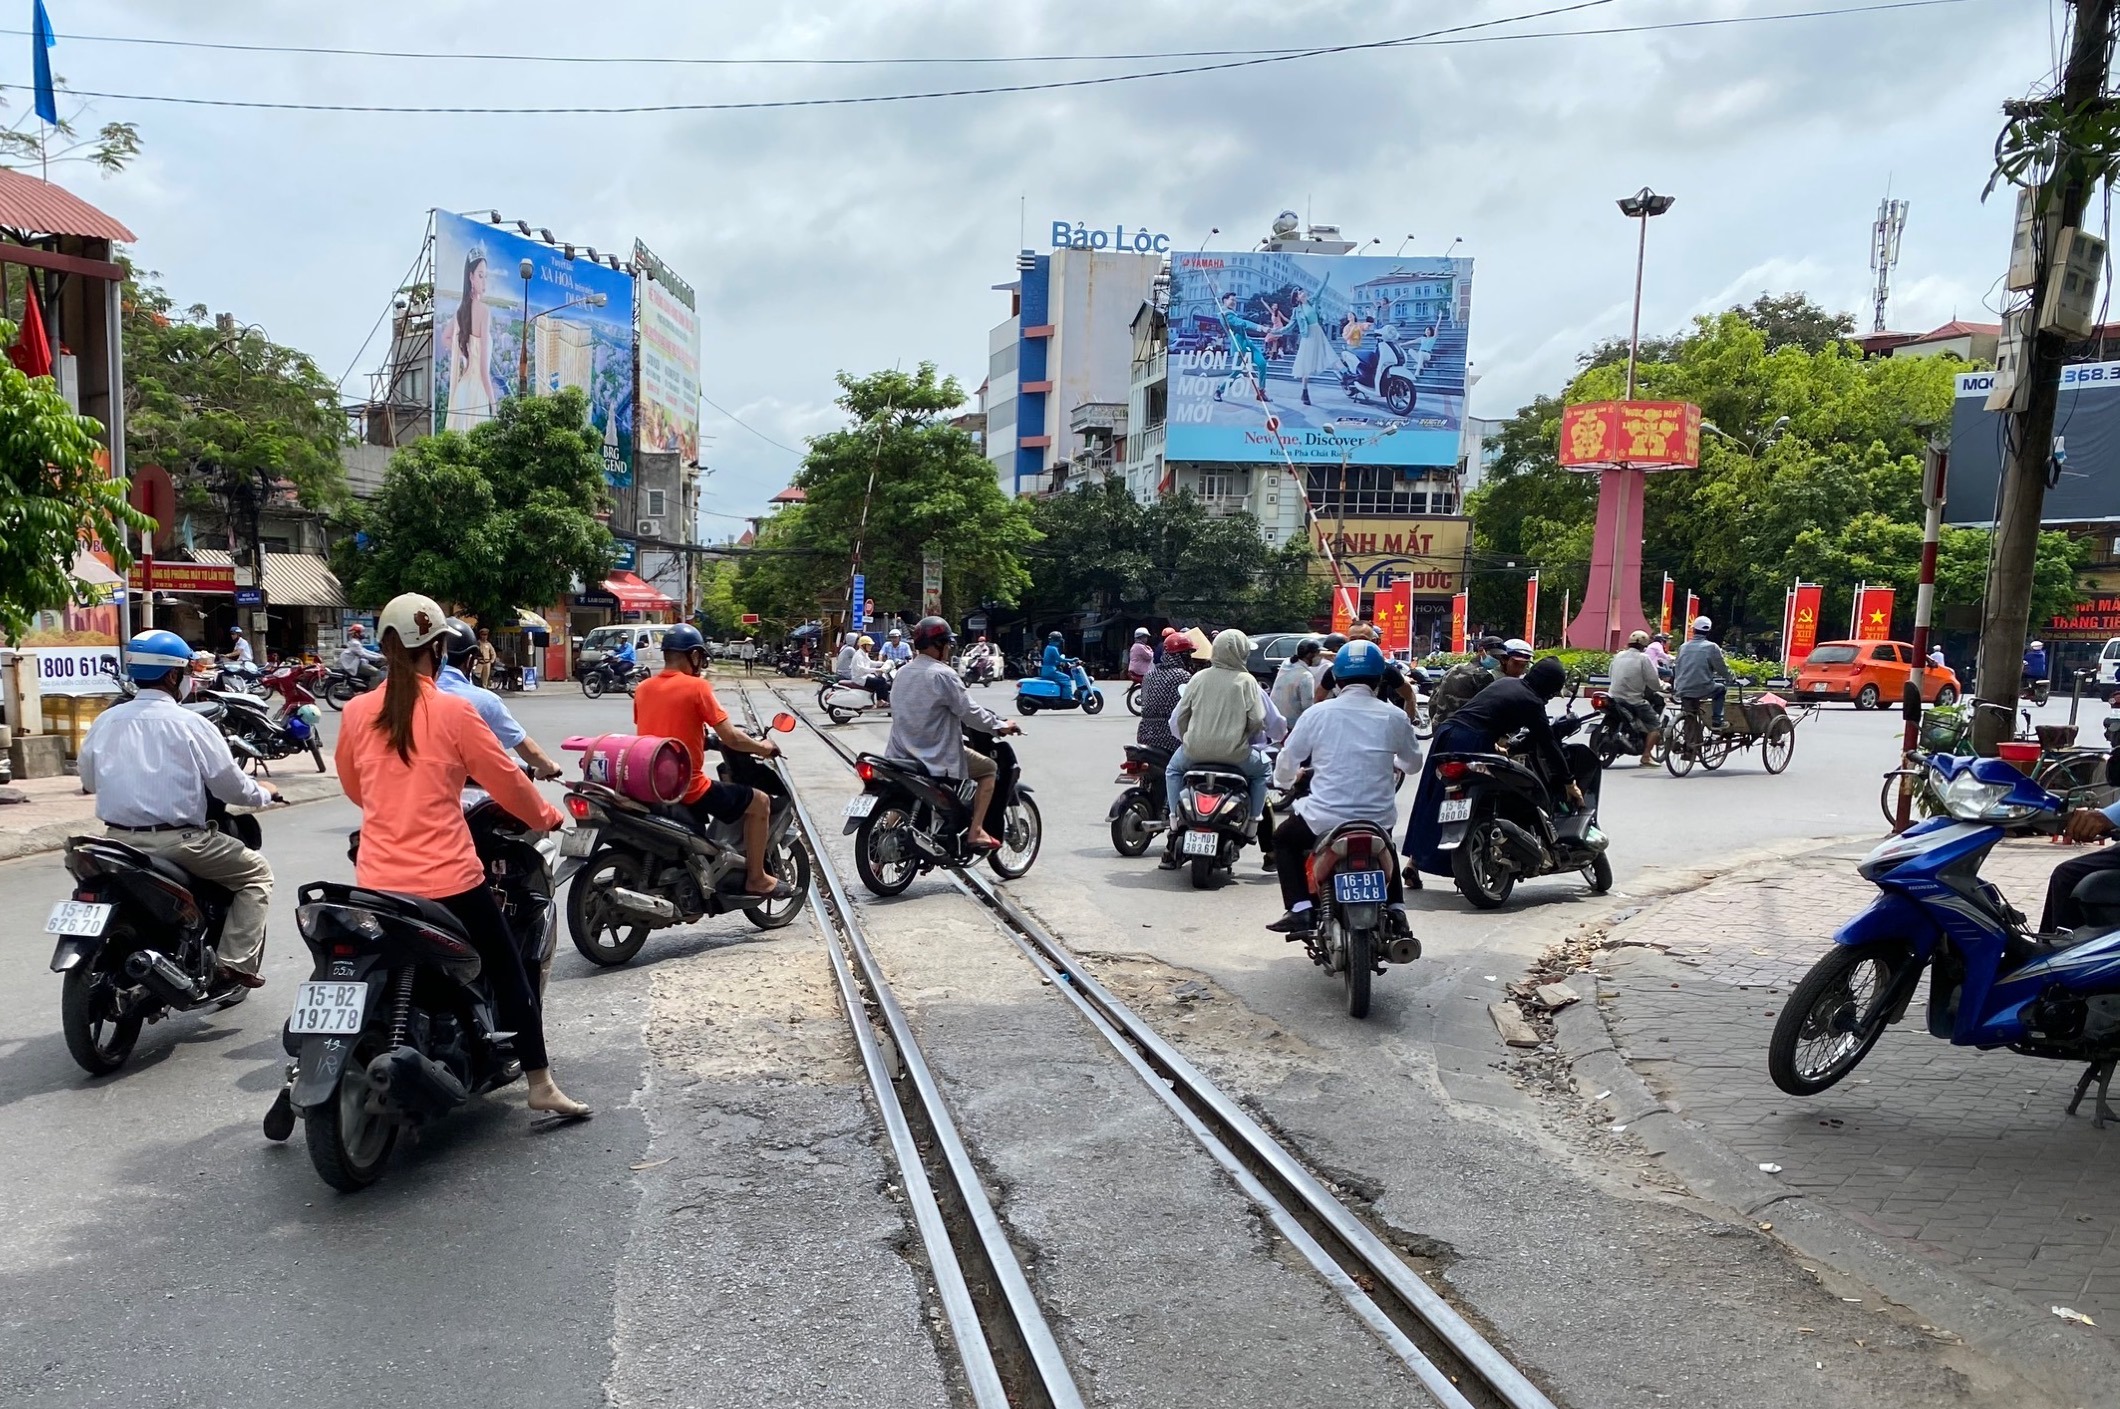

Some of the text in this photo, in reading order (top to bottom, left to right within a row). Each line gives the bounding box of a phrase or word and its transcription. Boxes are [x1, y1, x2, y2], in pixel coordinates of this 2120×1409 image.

[1052, 221, 1170, 257] Bảo Lộc
[1192, 259, 1225, 268] YAMAHA
[555, 270, 574, 289] HOA
[1178, 346, 1254, 371] LUÔN LÀ
[1177, 372, 1252, 398] MỘT TÔI
[1176, 397, 1215, 423] MỚI
[1245, 431, 1274, 445] New
[1305, 432, 1365, 446] Discover
[603, 445, 620, 460] BRG
[603, 459, 627, 474] GEND
[1383, 524, 1434, 554] MẮT
[1412, 566, 1453, 589] ĐỨC
[1415, 604, 1446, 613] HOYA
[1796, 630, 1812, 638] XIII
[1866, 632, 1884, 640] XIII
[1343, 873, 1377, 887] 16-B1
[1343, 887, 1379, 900] 0548
[61, 903, 101, 919] 15-B1
[47, 917, 101, 934] 626.70
[308, 985, 356, 1007] 15-B2
[298, 1008, 358, 1030] 197.78
